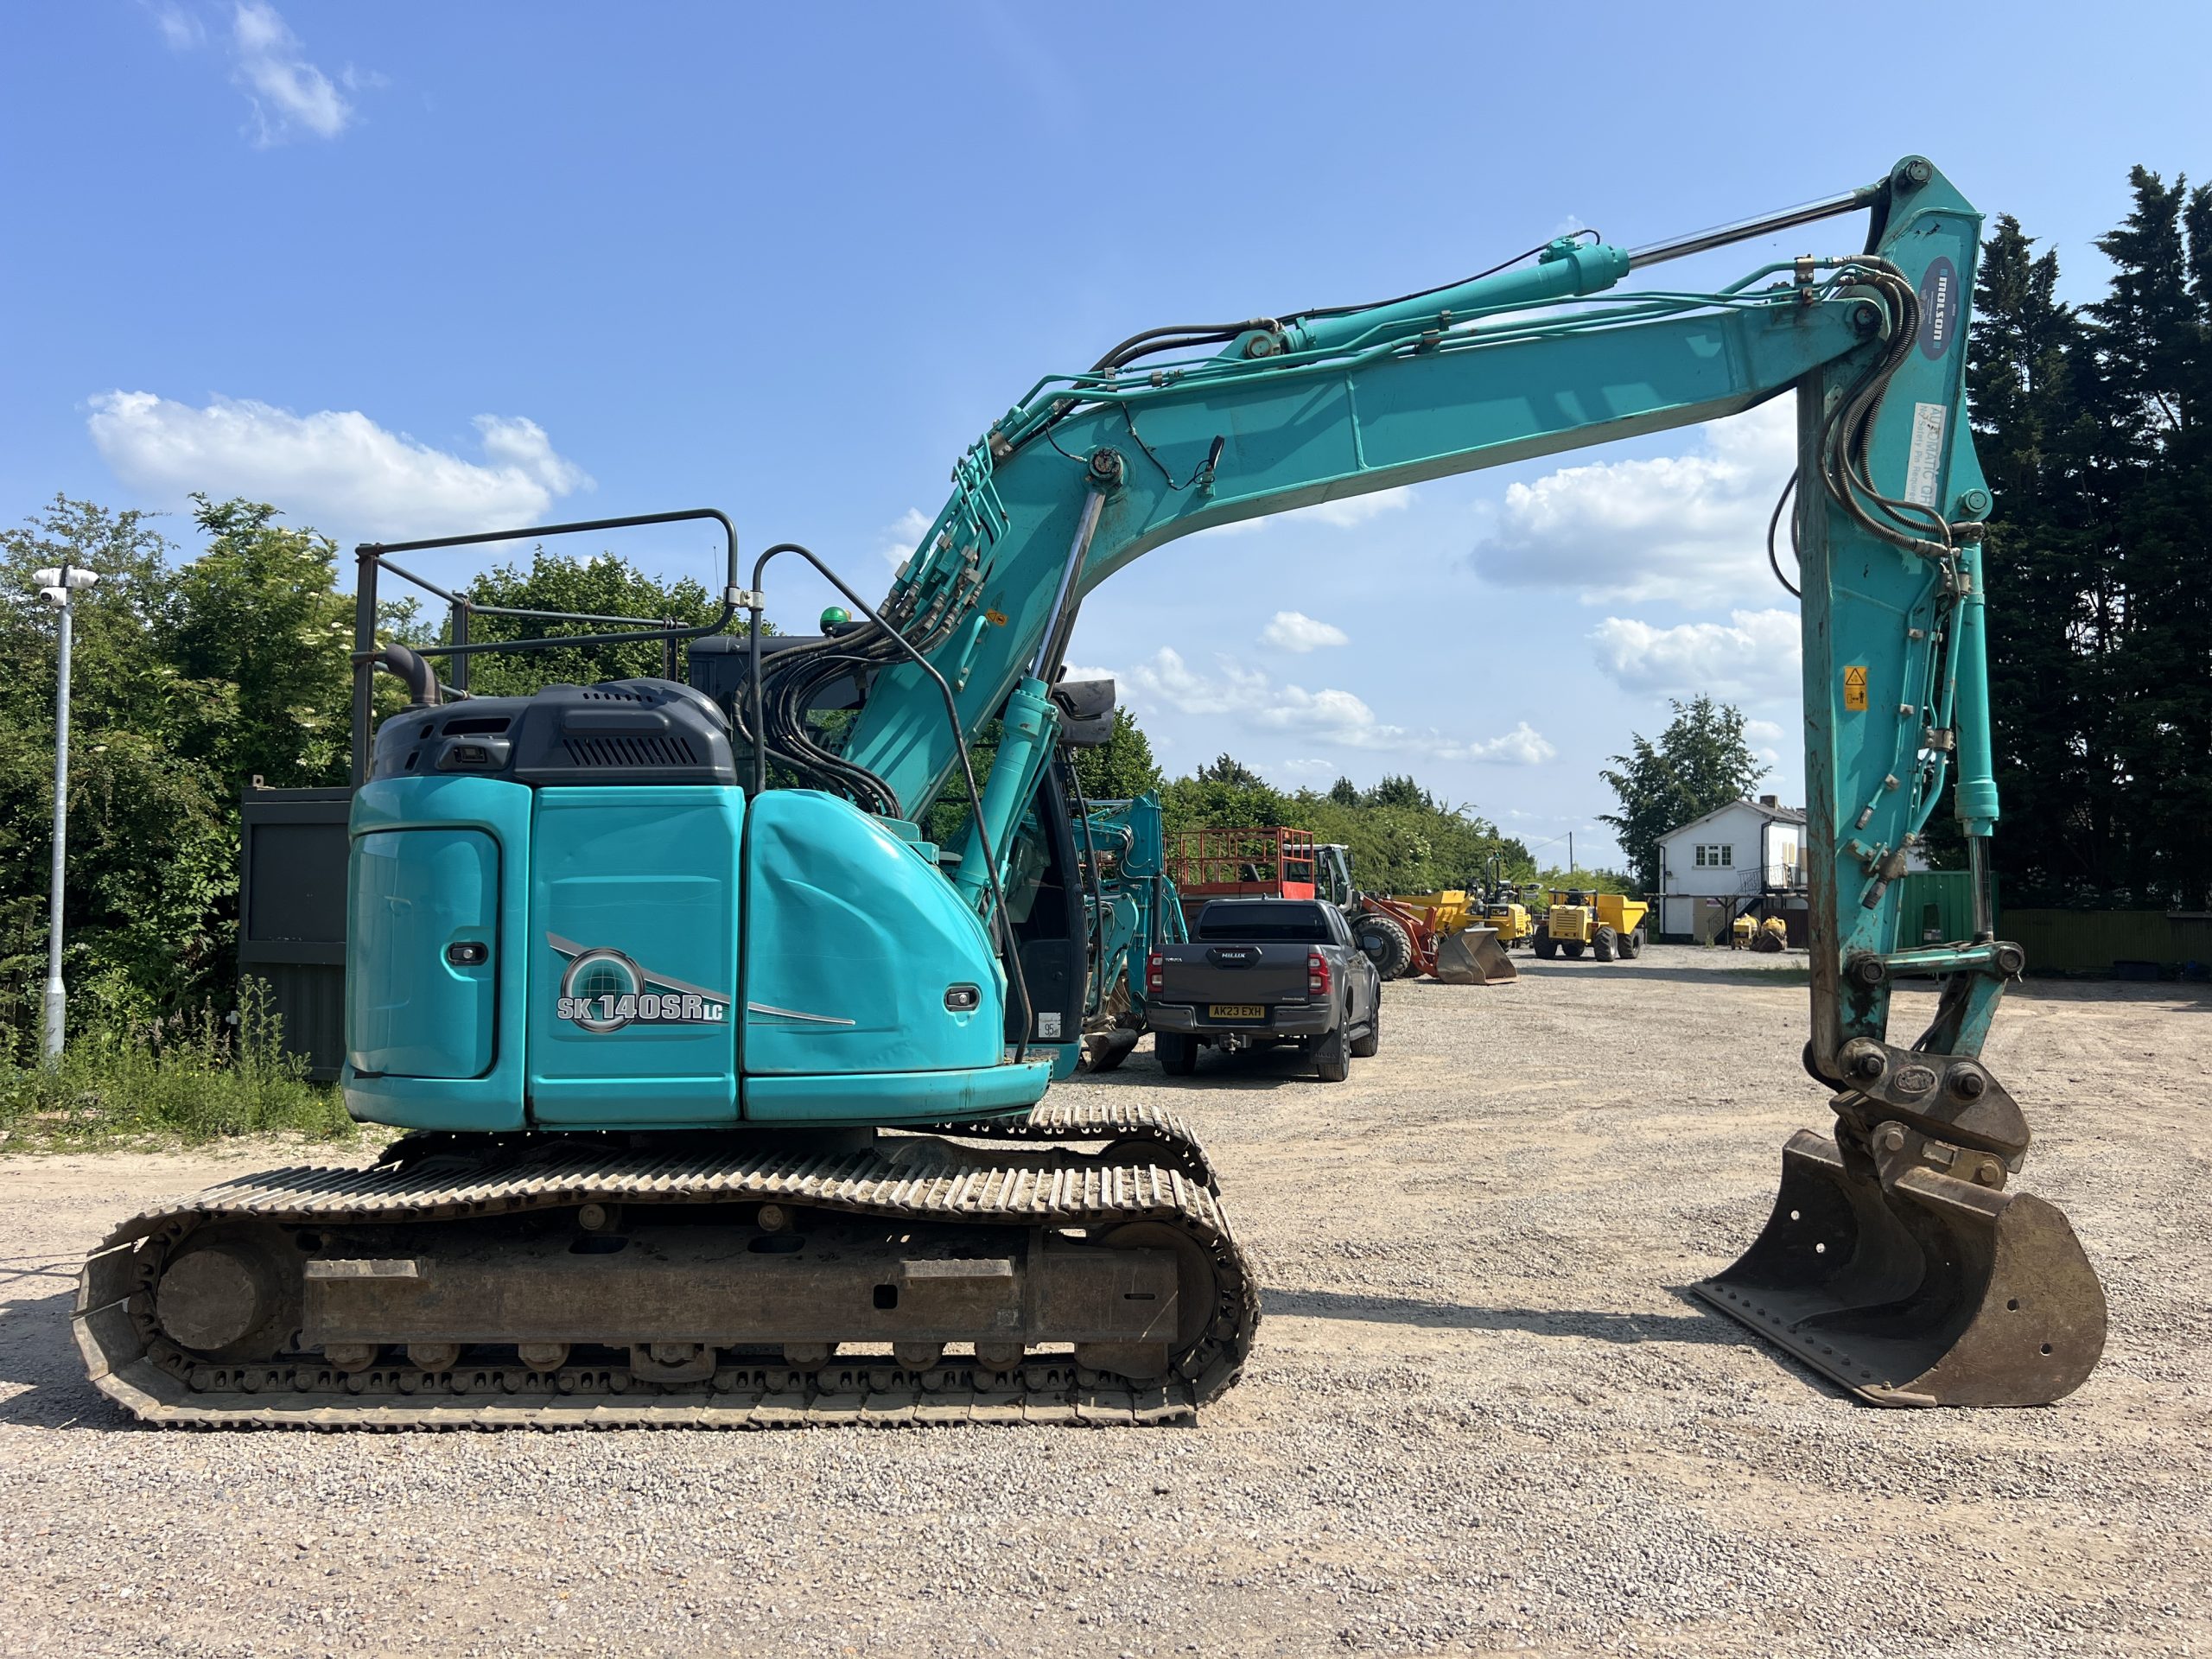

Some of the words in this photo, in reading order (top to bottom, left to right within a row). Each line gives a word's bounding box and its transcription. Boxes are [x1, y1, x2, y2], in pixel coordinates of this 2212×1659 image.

[1915, 420, 1926, 448] Safety
[557, 997, 592, 1020] SK
[1213, 1006, 1240, 1016] AK23
[1242, 1006, 1262, 1017] EXH
